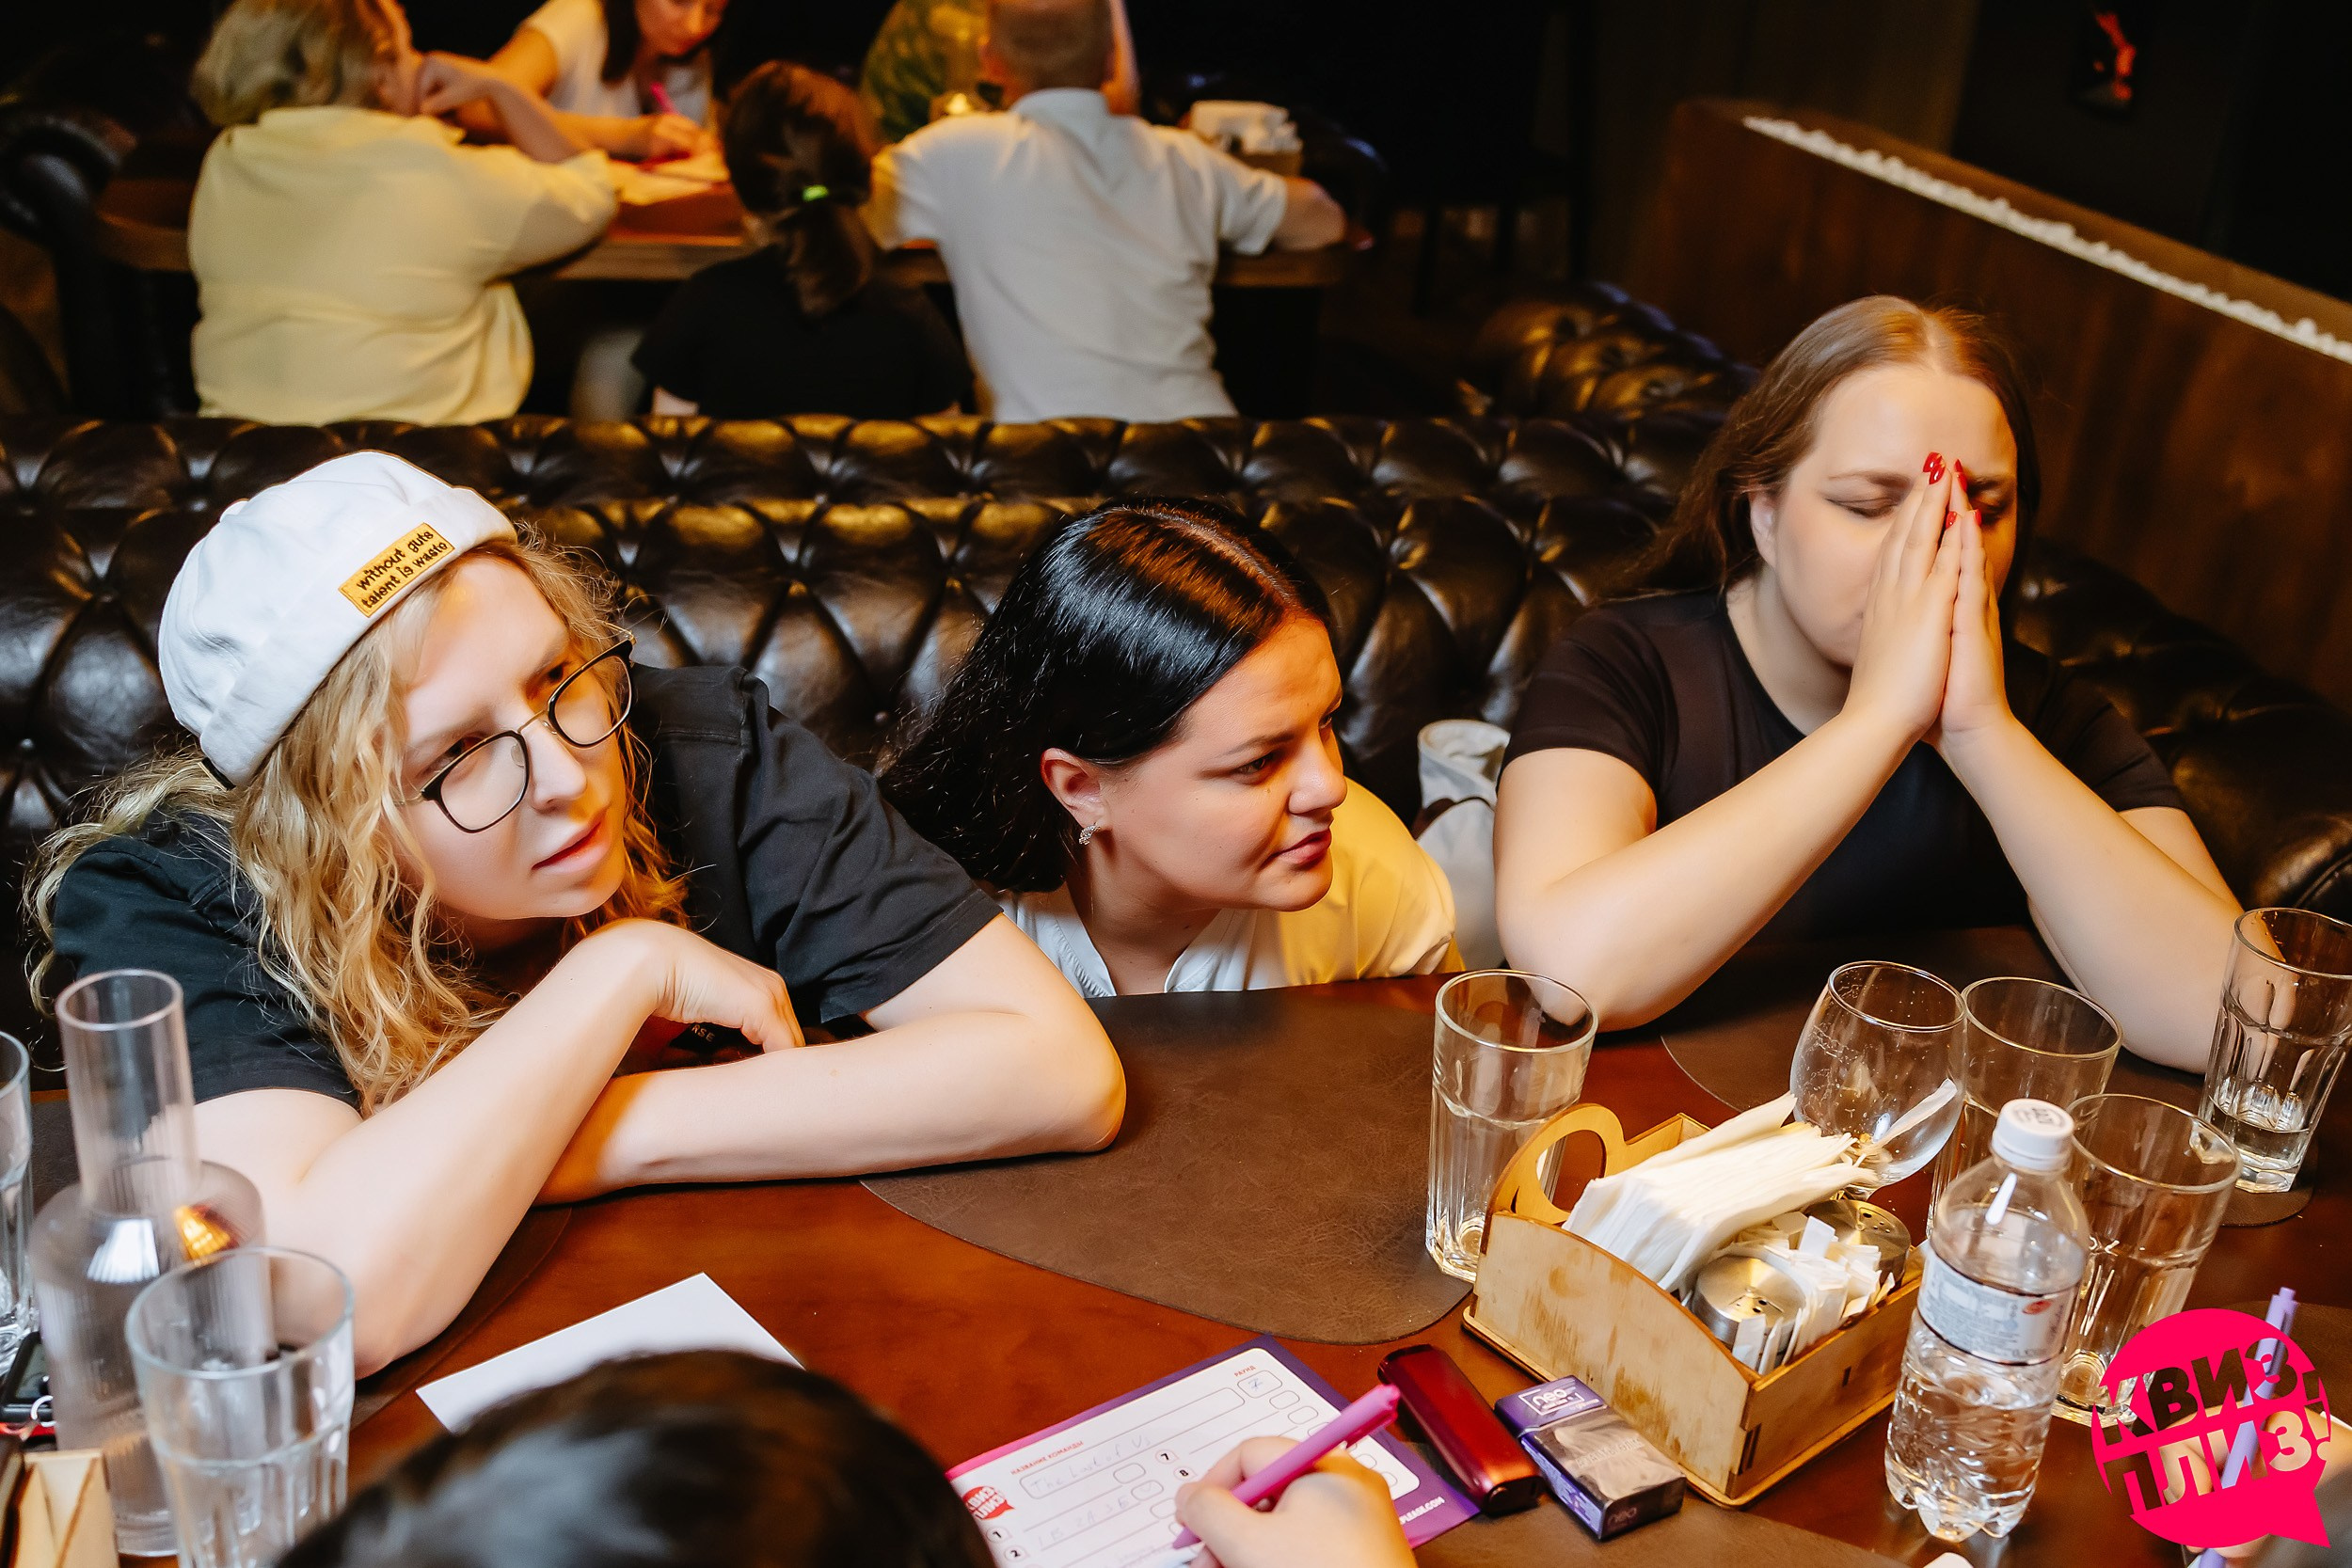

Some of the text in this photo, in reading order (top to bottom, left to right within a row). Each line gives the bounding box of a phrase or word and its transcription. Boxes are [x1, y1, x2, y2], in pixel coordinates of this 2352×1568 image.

[357, 531, 434, 591] without guts
[361, 541, 448, 609] talent is waste
[1233, 1365, 1256, 1377] РАУНД
[1532, 1388, 1567, 1406] neo
[1048, 1440, 1084, 1459] КОМАНДЫ
